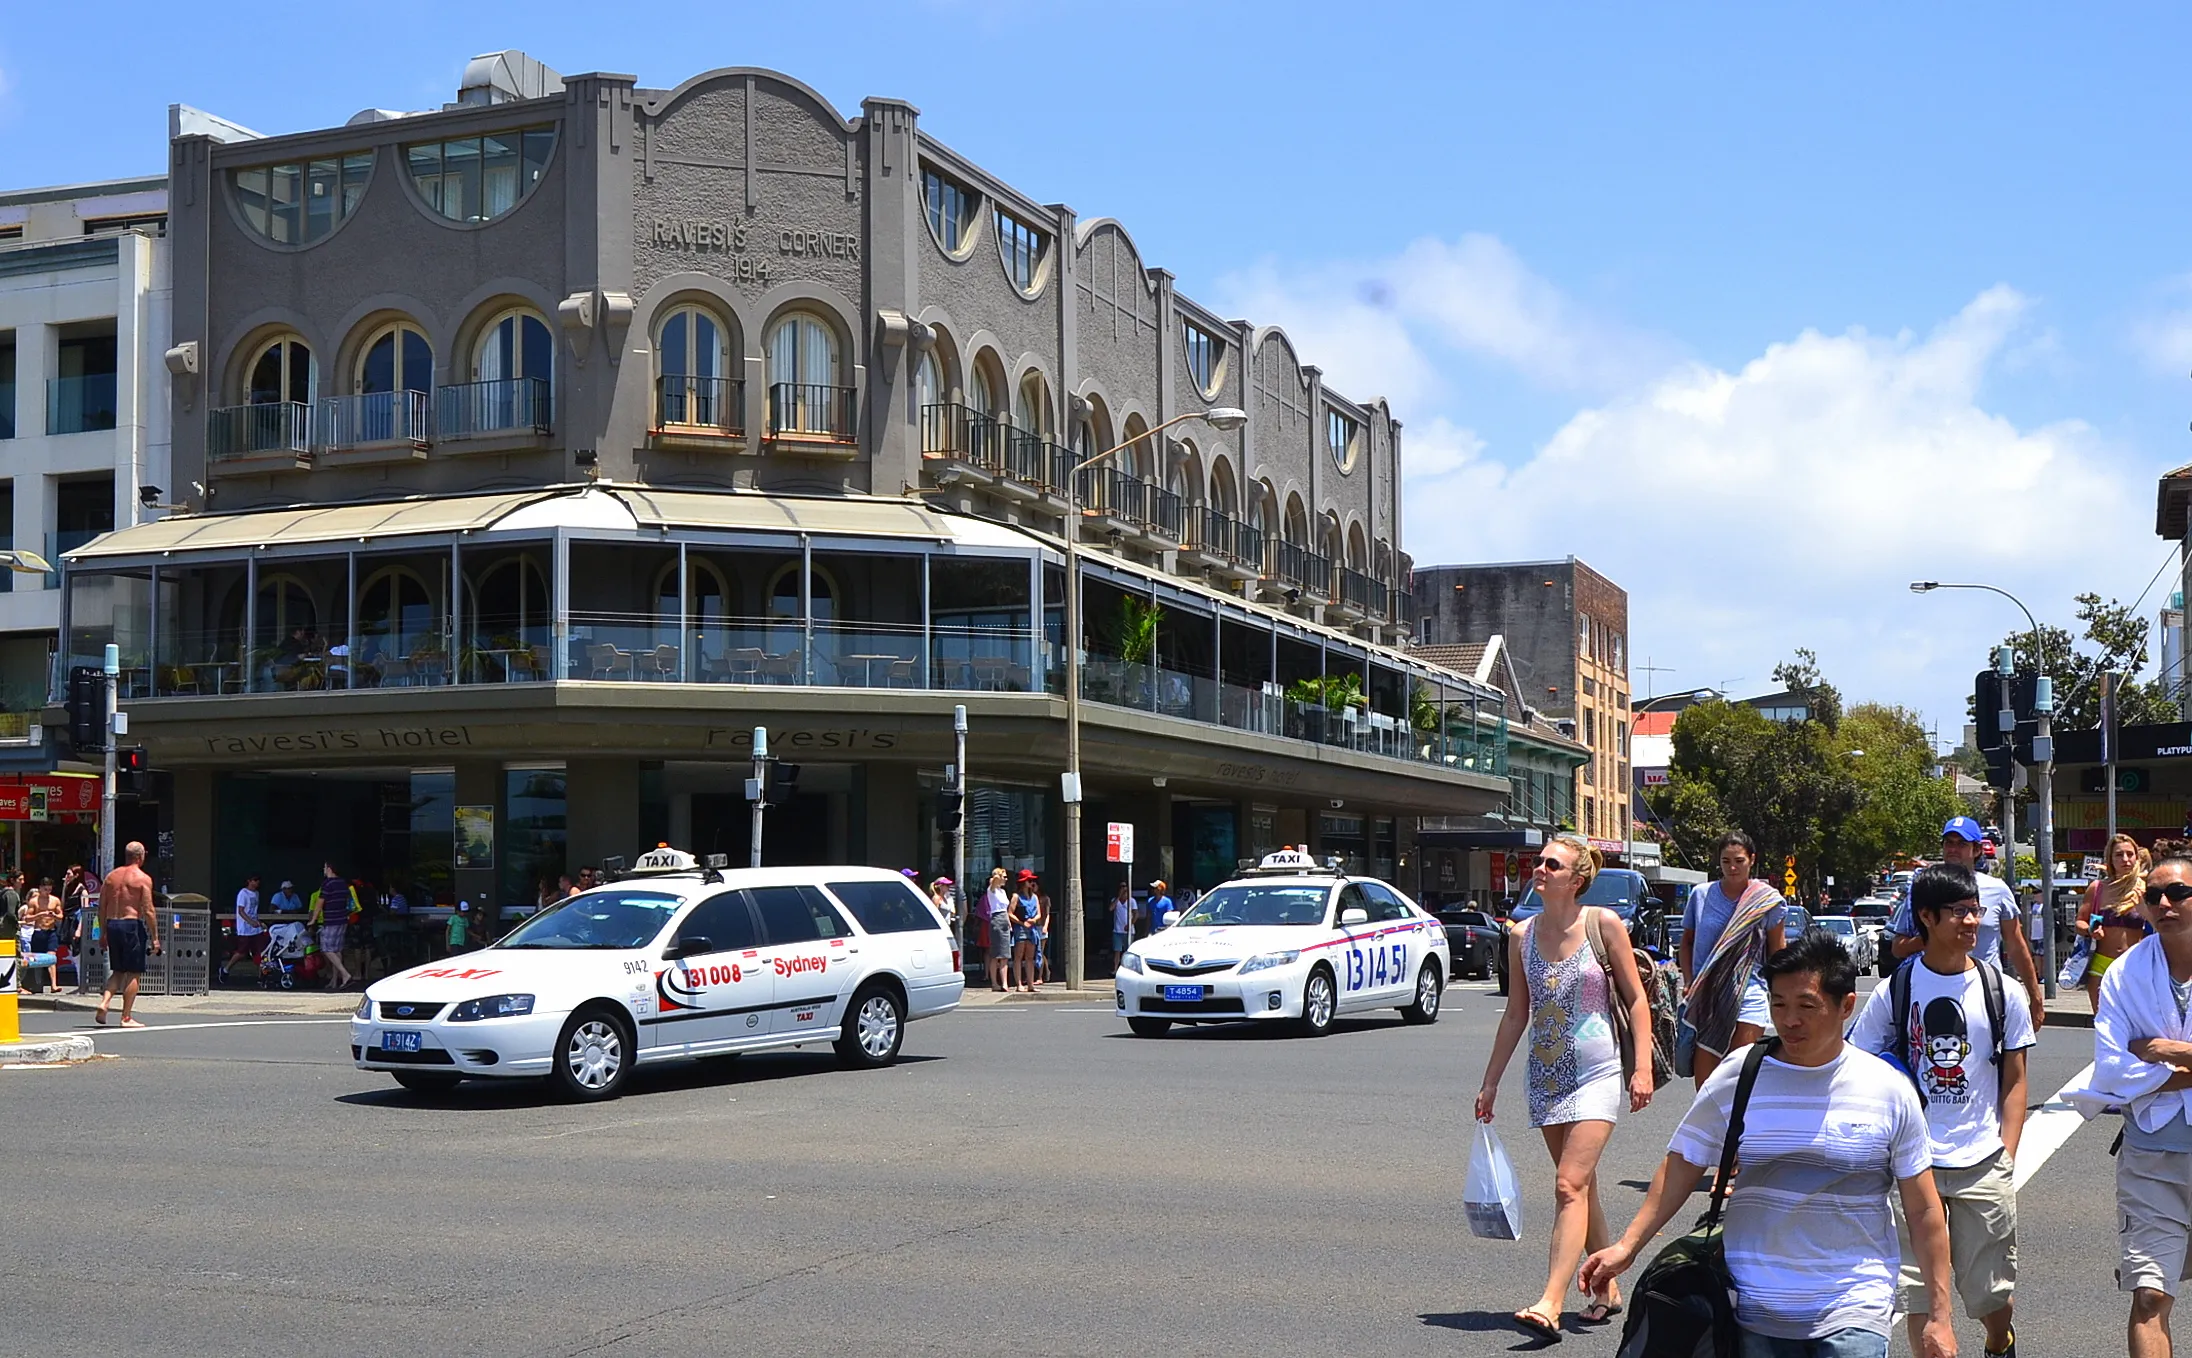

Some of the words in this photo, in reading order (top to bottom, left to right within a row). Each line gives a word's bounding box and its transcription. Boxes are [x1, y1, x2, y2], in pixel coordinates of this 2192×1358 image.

[653, 217, 748, 249] RAVESI'S
[779, 230, 860, 260] CORNER
[732, 255, 772, 280] 1914
[207, 730, 359, 753] ravesi's
[378, 726, 472, 747] hotel
[707, 729, 895, 749] ravesi's
[644, 855, 675, 867] TAXI
[1271, 855, 1301, 864] TAXI
[405, 968, 504, 980] TAXI
[623, 960, 649, 975] 9142
[773, 955, 827, 978] Sydney
[796, 1012, 814, 1022] TAXI
[1952, 1095, 1971, 1104] BABY
